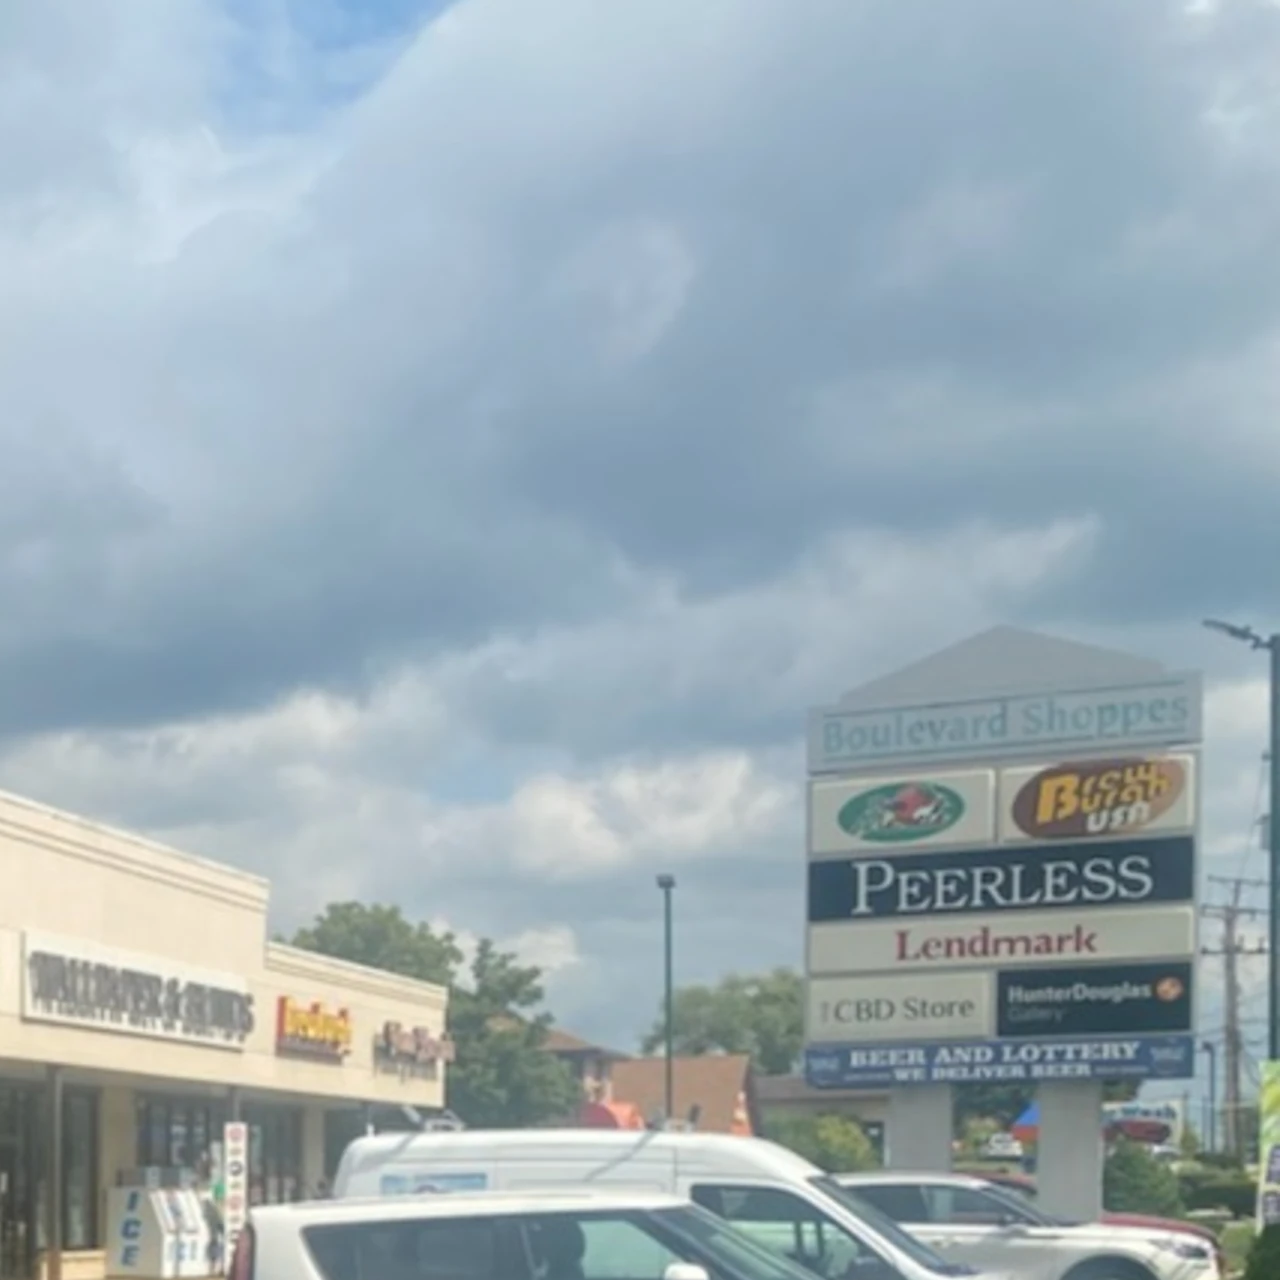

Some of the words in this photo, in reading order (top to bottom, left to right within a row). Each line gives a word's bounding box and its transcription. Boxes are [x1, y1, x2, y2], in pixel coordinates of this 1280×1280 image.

[822, 705, 1008, 755] Boulevard
[1020, 694, 1189, 739] Shoppes
[851, 856, 1154, 916] PEERLESS
[895, 926, 1099, 962] Lendmark
[833, 995, 896, 1024] CBD
[903, 992, 975, 1020] Store
[1007, 979, 1152, 1005] HunterDouglas
[850, 1047, 926, 1069] BEER
[933, 1045, 994, 1065] AND
[1000, 1041, 1141, 1063] LOTTERY
[893, 1067, 925, 1082] WE
[931, 1065, 1024, 1080] DELIVER
[1029, 1063, 1092, 1078] BEER
[120, 1190, 143, 1267] ICE
